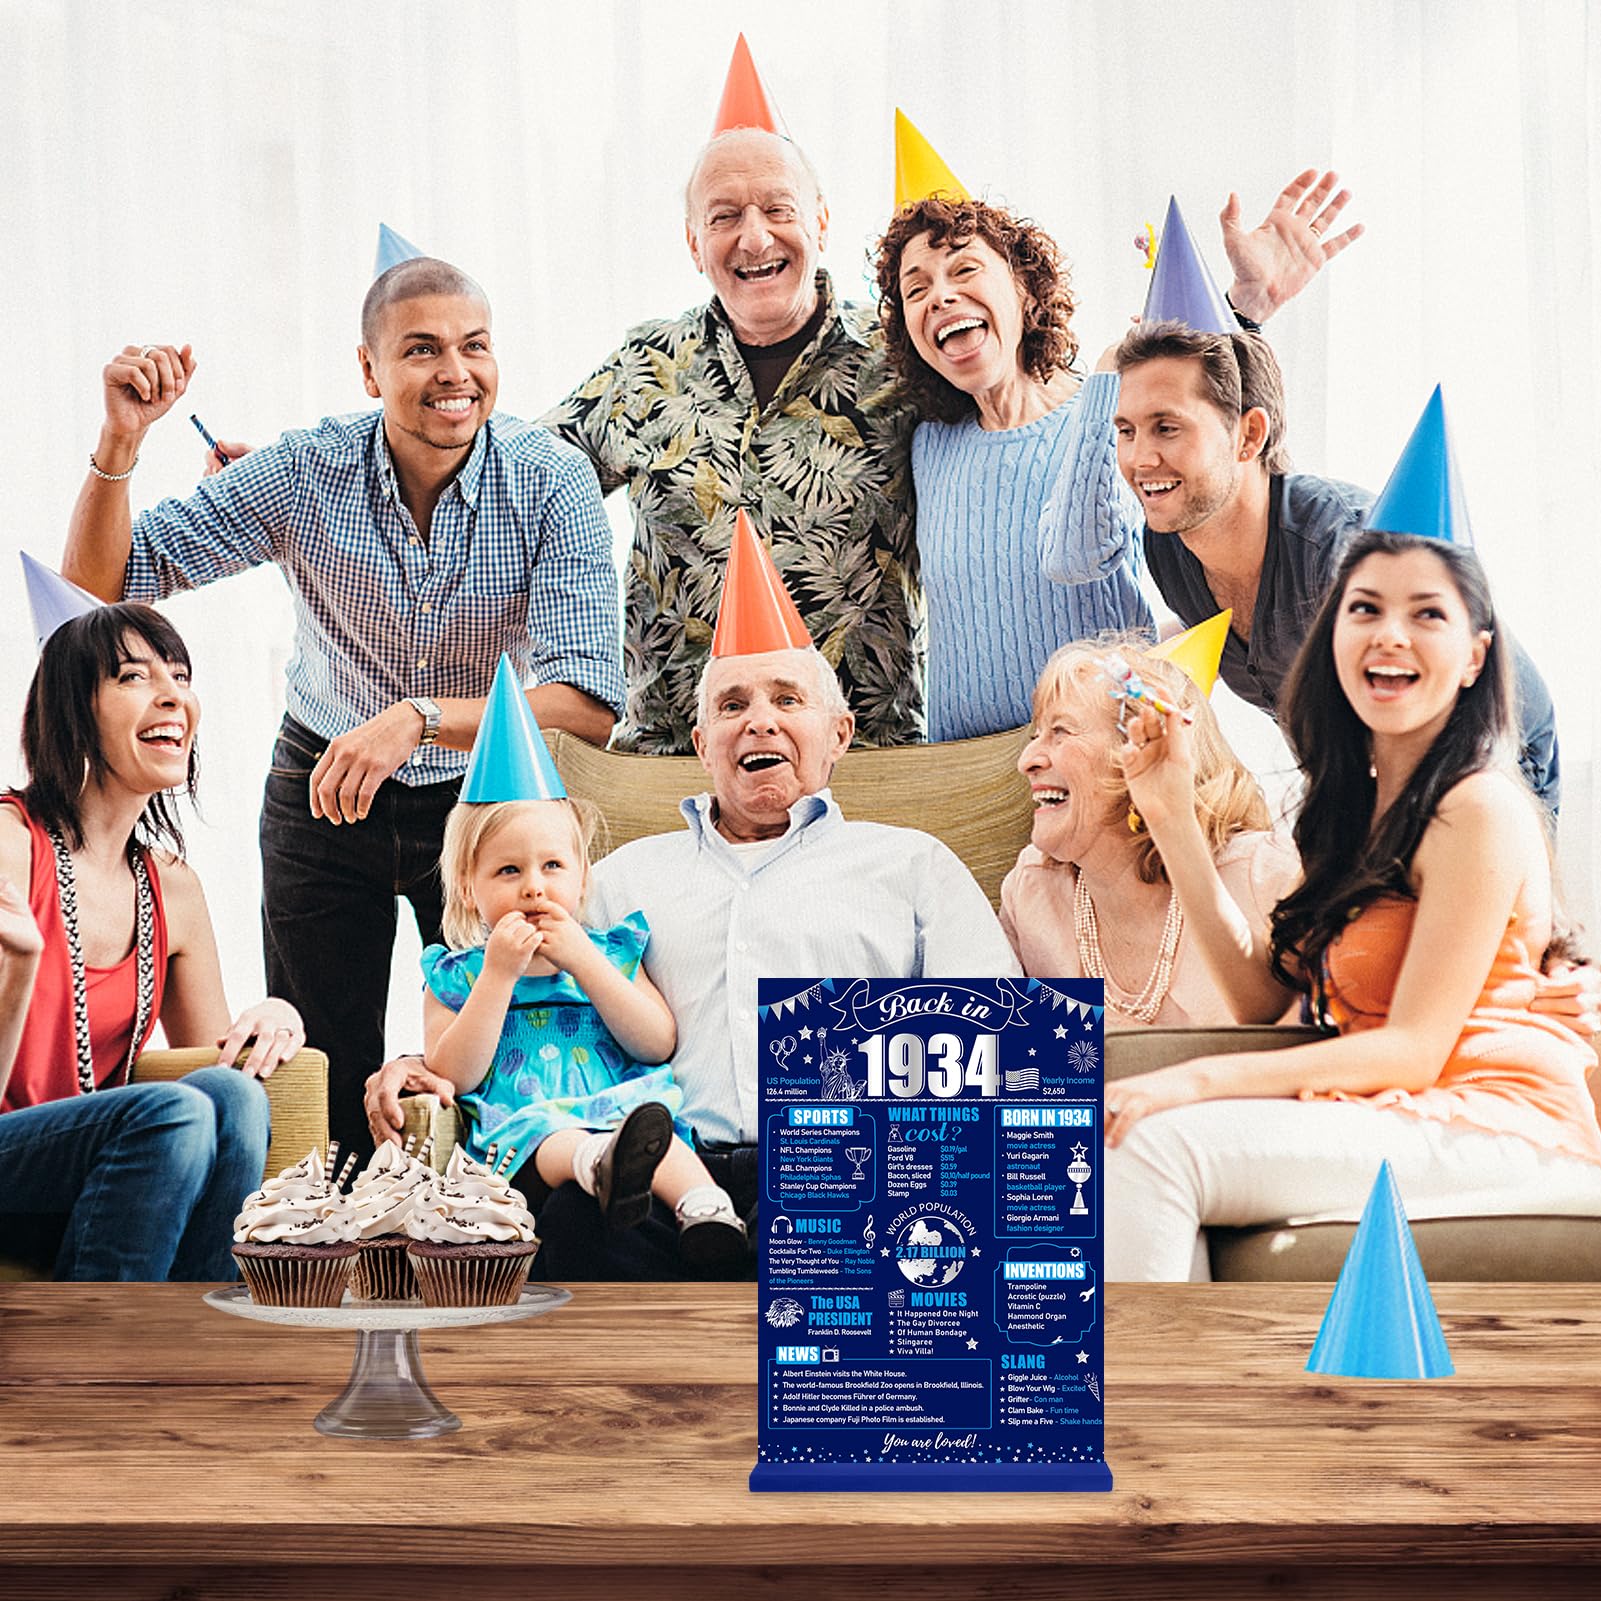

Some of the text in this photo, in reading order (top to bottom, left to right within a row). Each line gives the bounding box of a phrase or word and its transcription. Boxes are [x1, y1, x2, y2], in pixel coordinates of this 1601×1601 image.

[880, 992, 992, 1022] Back in
[858, 1033, 1003, 1098] 1934
[767, 1077, 820, 1086] US Population
[1042, 1076, 1065, 1085] Yearly
[794, 1109, 848, 1124] SPORTS
[887, 1107, 980, 1121] WHAT THINGS
[1003, 1109, 1090, 1126] BORN IN 1934
[823, 1129, 860, 1137] Champions
[905, 1122, 962, 1142] cost?
[1007, 1131, 1054, 1140] Maggie Smith
[795, 1147, 832, 1155] Champions
[940, 1153, 955, 1162] $515
[1022, 1152, 1049, 1161] Gagarin
[795, 1165, 832, 1173] Champions
[780, 1183, 856, 1191] Stanley Cup Champions
[910, 1181, 927, 1189] Eggs
[888, 1190, 909, 1198] Stamp
[1007, 1193, 1053, 1202] Sophia Loren
[886, 1202, 977, 1237] WORLD POPULATION
[1007, 1214, 1032, 1223] Giorgio
[796, 1218, 841, 1233] MUSIC
[1007, 1224, 1064, 1233] fashion designer
[895, 1246, 966, 1258] 2.17 BILLION
[781, 1258, 795, 1266] Very
[795, 1258, 820, 1266] Thought
[1006, 1263, 1084, 1278] INVENTIONS
[1007, 1283, 1047, 1291] Trampoline
[911, 1292, 967, 1307] MOVIES
[1038, 1292, 1066, 1301] (puzzle)
[811, 1295, 860, 1309] The USA
[904, 1310, 941, 1318] Happened
[959, 1310, 978, 1318] Night
[1045, 1313, 1066, 1321] Organ
[808, 1312, 873, 1326] PRESIDENT
[912, 1319, 926, 1328] Gay
[935, 1329, 967, 1337] Bondage
[897, 1338, 933, 1347] Stingaree
[779, 1347, 818, 1361] NEWS
[1001, 1354, 1045, 1369] SLANG
[1008, 1374, 1029, 1382] Giggle
[1042, 1385, 1055, 1393] Wig
[821, 1404, 840, 1413] Clyde
[875, 1405, 894, 1413] police
[783, 1416, 815, 1424] Japanese
[848, 1416, 860, 1424] Fuji
[1008, 1418, 1021, 1426] Slip
[881, 1431, 977, 1454] You are loved!
